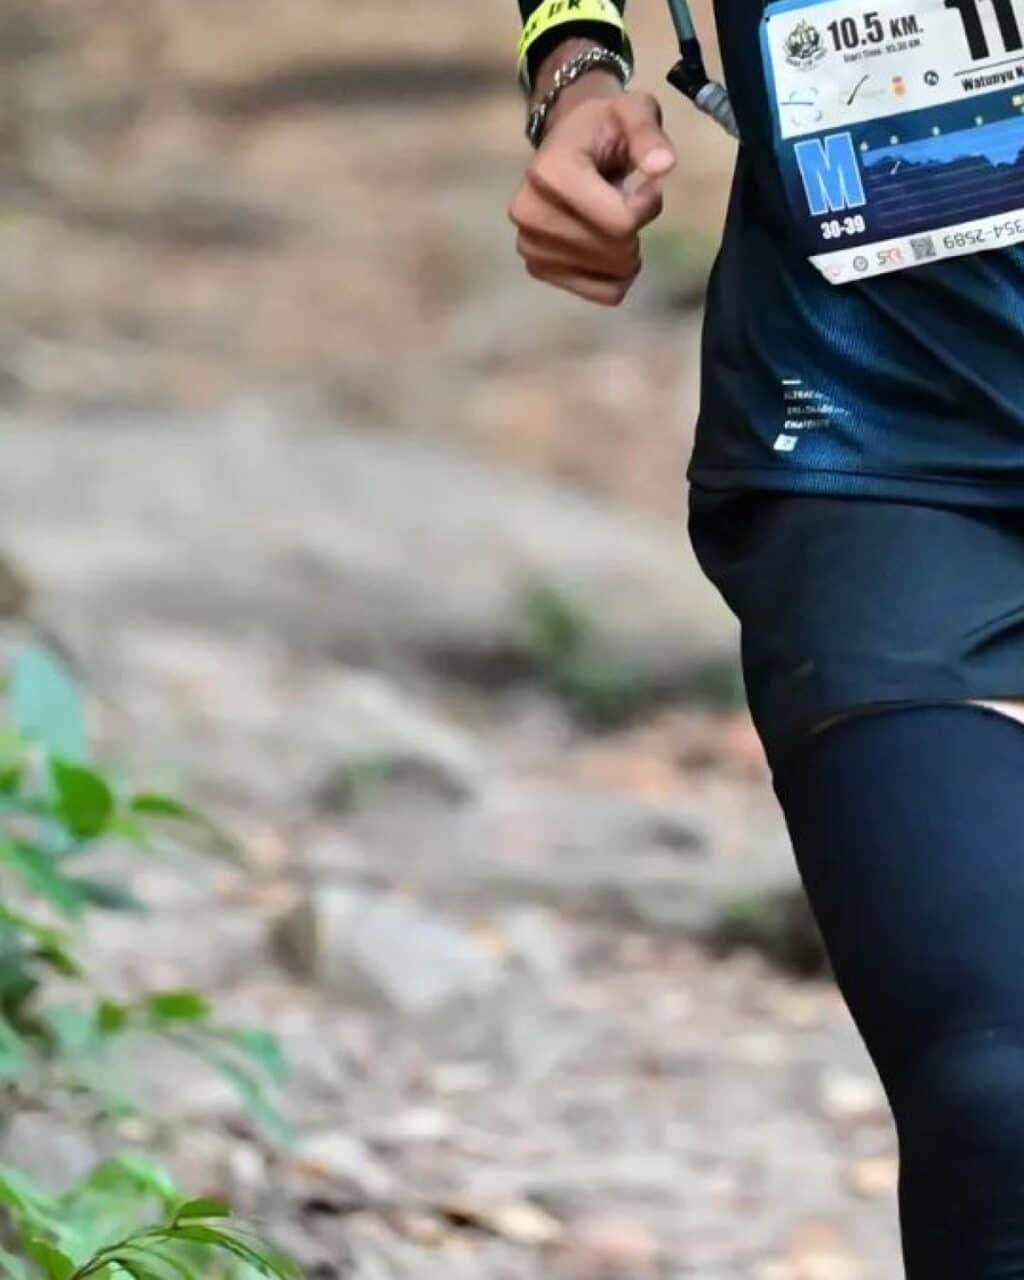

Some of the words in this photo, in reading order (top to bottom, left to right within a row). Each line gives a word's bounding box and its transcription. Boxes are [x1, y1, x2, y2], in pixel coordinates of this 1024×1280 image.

[827, 11, 885, 51] 10.5
[889, 15, 924, 40] KM.
[794, 133, 866, 215] M
